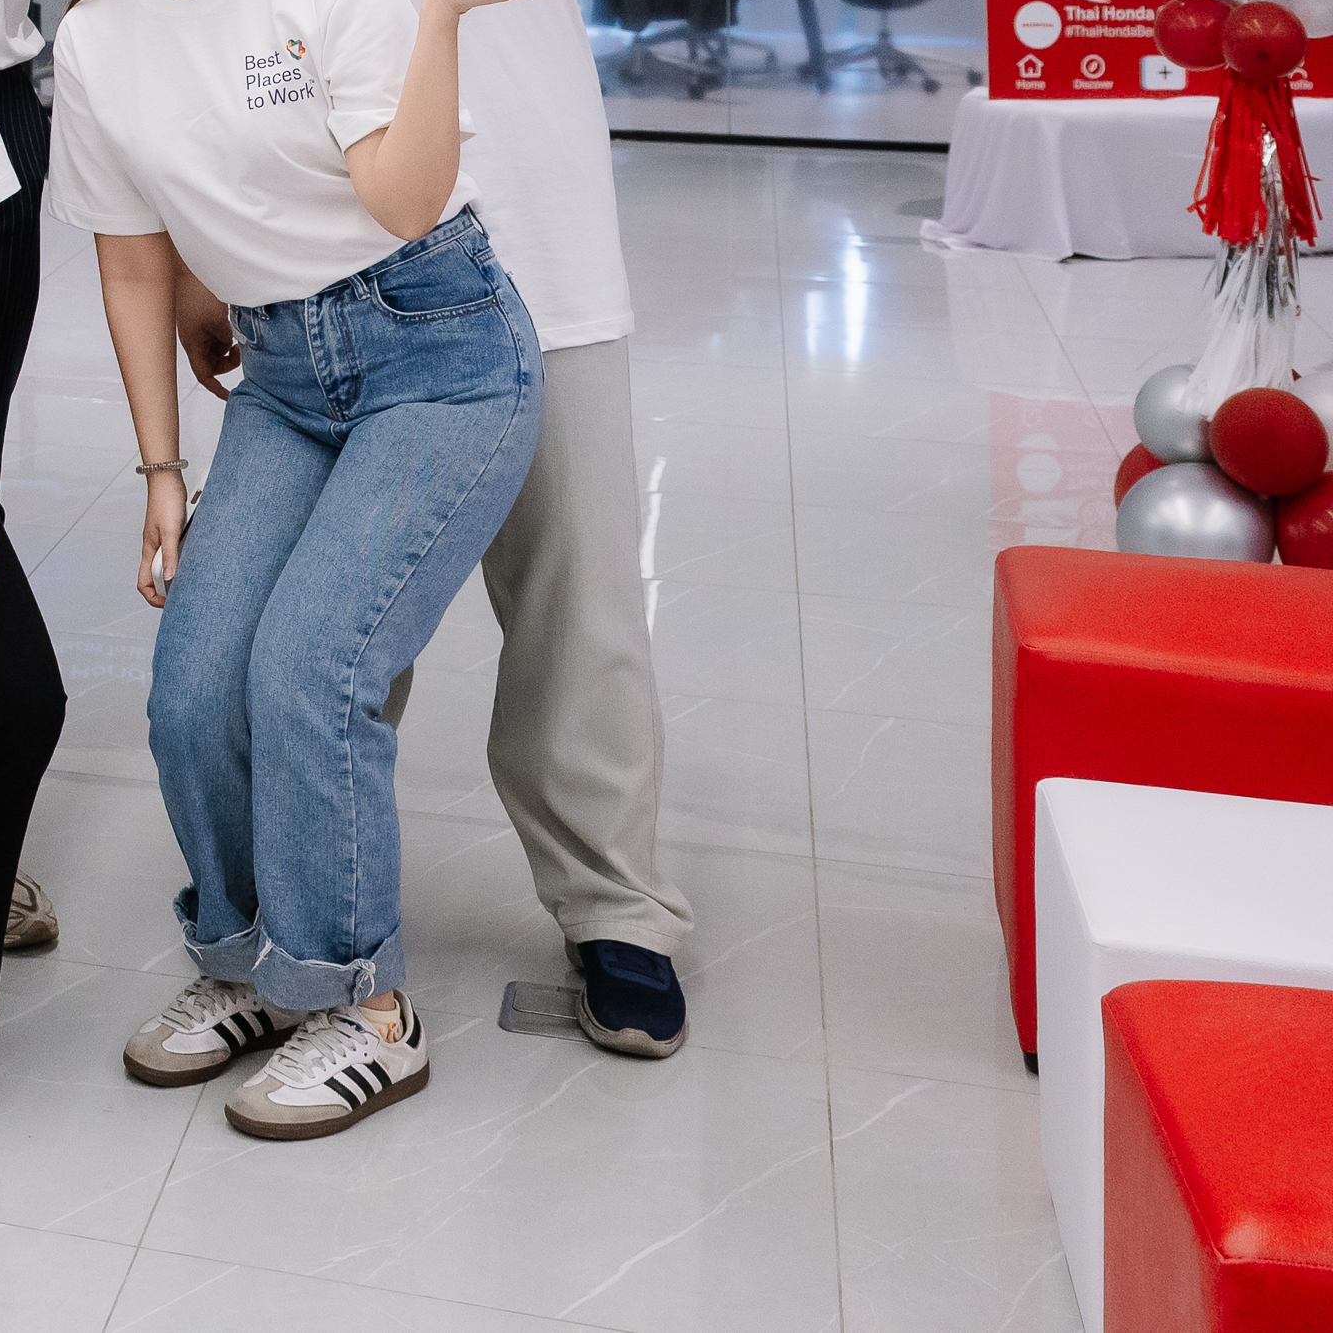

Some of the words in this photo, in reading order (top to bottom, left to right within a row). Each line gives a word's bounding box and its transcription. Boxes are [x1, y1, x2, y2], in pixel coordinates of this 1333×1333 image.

[1064, 5, 1100, 21] Thai
[1101, 5, 1155, 22] Honda
[1064, 24, 1155, 38] #ThaiHondaBe
[244, 50, 283, 71] Best
[245, 67, 302, 91] Places
[246, 96, 265, 110] to
